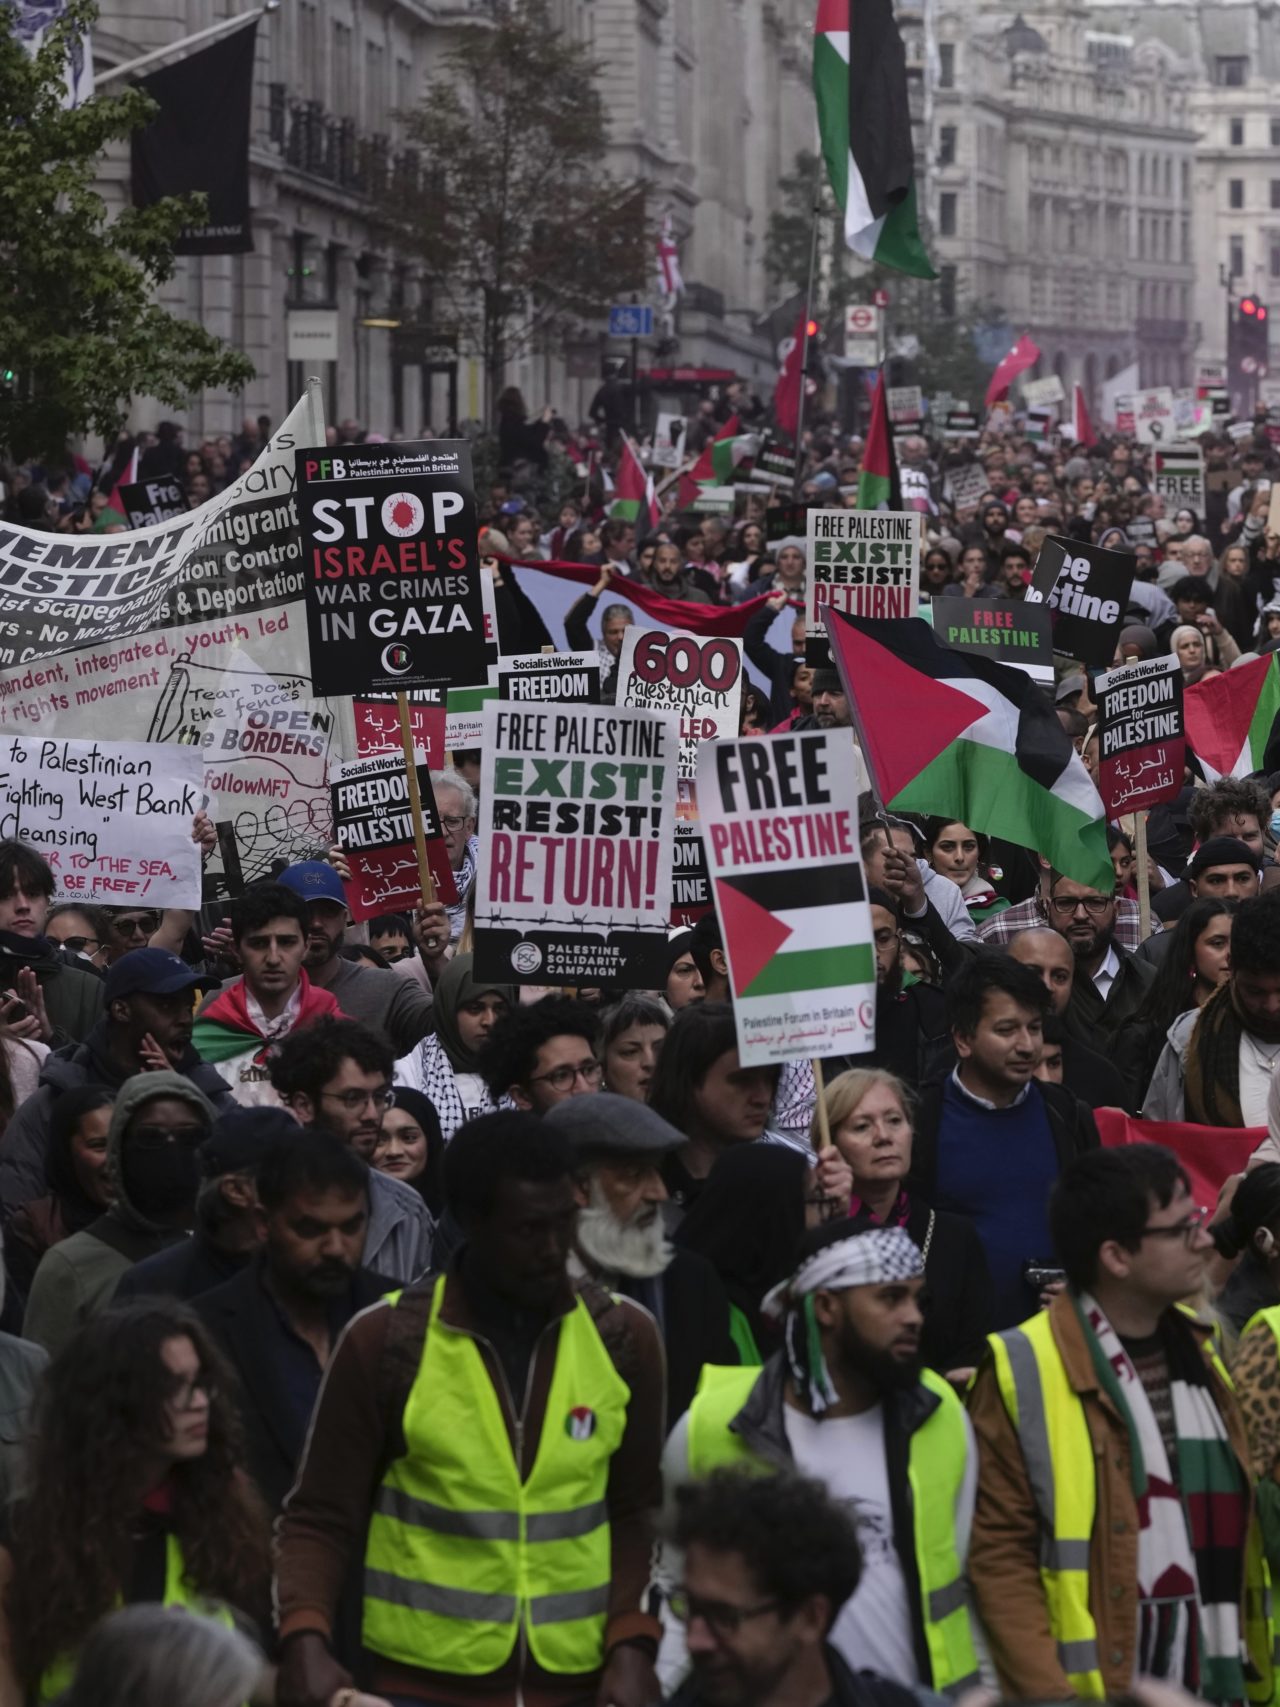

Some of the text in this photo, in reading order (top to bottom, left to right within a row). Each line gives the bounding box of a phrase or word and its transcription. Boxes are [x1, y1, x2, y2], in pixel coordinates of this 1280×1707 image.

[305, 458, 346, 481] PFB
[350, 463, 459, 478] Palestinian Forum in Britain
[312, 491, 464, 542] STOP
[815, 516, 844, 537] FREE
[849, 517, 912, 539] PALESTINE
[313, 538, 467, 579] ISRAEL'S
[815, 541, 912, 565] EXIST!
[815, 565, 911, 585] RESIST!
[177, 591, 193, 616] &
[315, 575, 469, 605] WAR CRIMES
[39, 624, 69, 642] No
[74, 621, 121, 641] More
[186, 625, 249, 654] youth
[258, 611, 289, 636] led
[320, 612, 356, 641] IN
[369, 604, 472, 638] GAZA
[973, 611, 1013, 628] FREE
[949, 627, 1039, 648] PALESTINE
[633, 631, 740, 692] 600
[13, 669, 159, 722] rights movement
[508, 673, 589, 700] FREEDOM
[1105, 677, 1173, 718] FREEDOM
[191, 690, 301, 722] the fences
[1131, 708, 1144, 720] for
[247, 709, 330, 733] OPEN
[459, 721, 483, 731] Britain
[496, 712, 548, 751] FREE
[554, 715, 666, 758] PALESTINE
[1104, 711, 1179, 755] PALESTINE
[178, 723, 214, 748] the
[220, 728, 325, 757] BORDERS
[9, 738, 152, 777] to Palestinian
[1115, 748, 1166, 777] الحرية
[494, 757, 665, 803] EXIST!
[716, 736, 831, 814] FREE
[1111, 770, 1173, 807] لفلسطين
[79, 778, 129, 810] West
[136, 783, 197, 817] Bank
[373, 805, 387, 818] for
[492, 800, 662, 838] RESIST!
[710, 810, 853, 867] PALESTINE
[69, 853, 177, 880] TO THE SEA,
[489, 833, 660, 910] RETURN!
[64, 874, 86, 890] BE
[547, 954, 627, 966] SOLIDARITY
[548, 944, 620, 956] PALESTINE
[547, 965, 616, 976] CAMPAIGN
[822, 1006, 854, 1020] Britain
